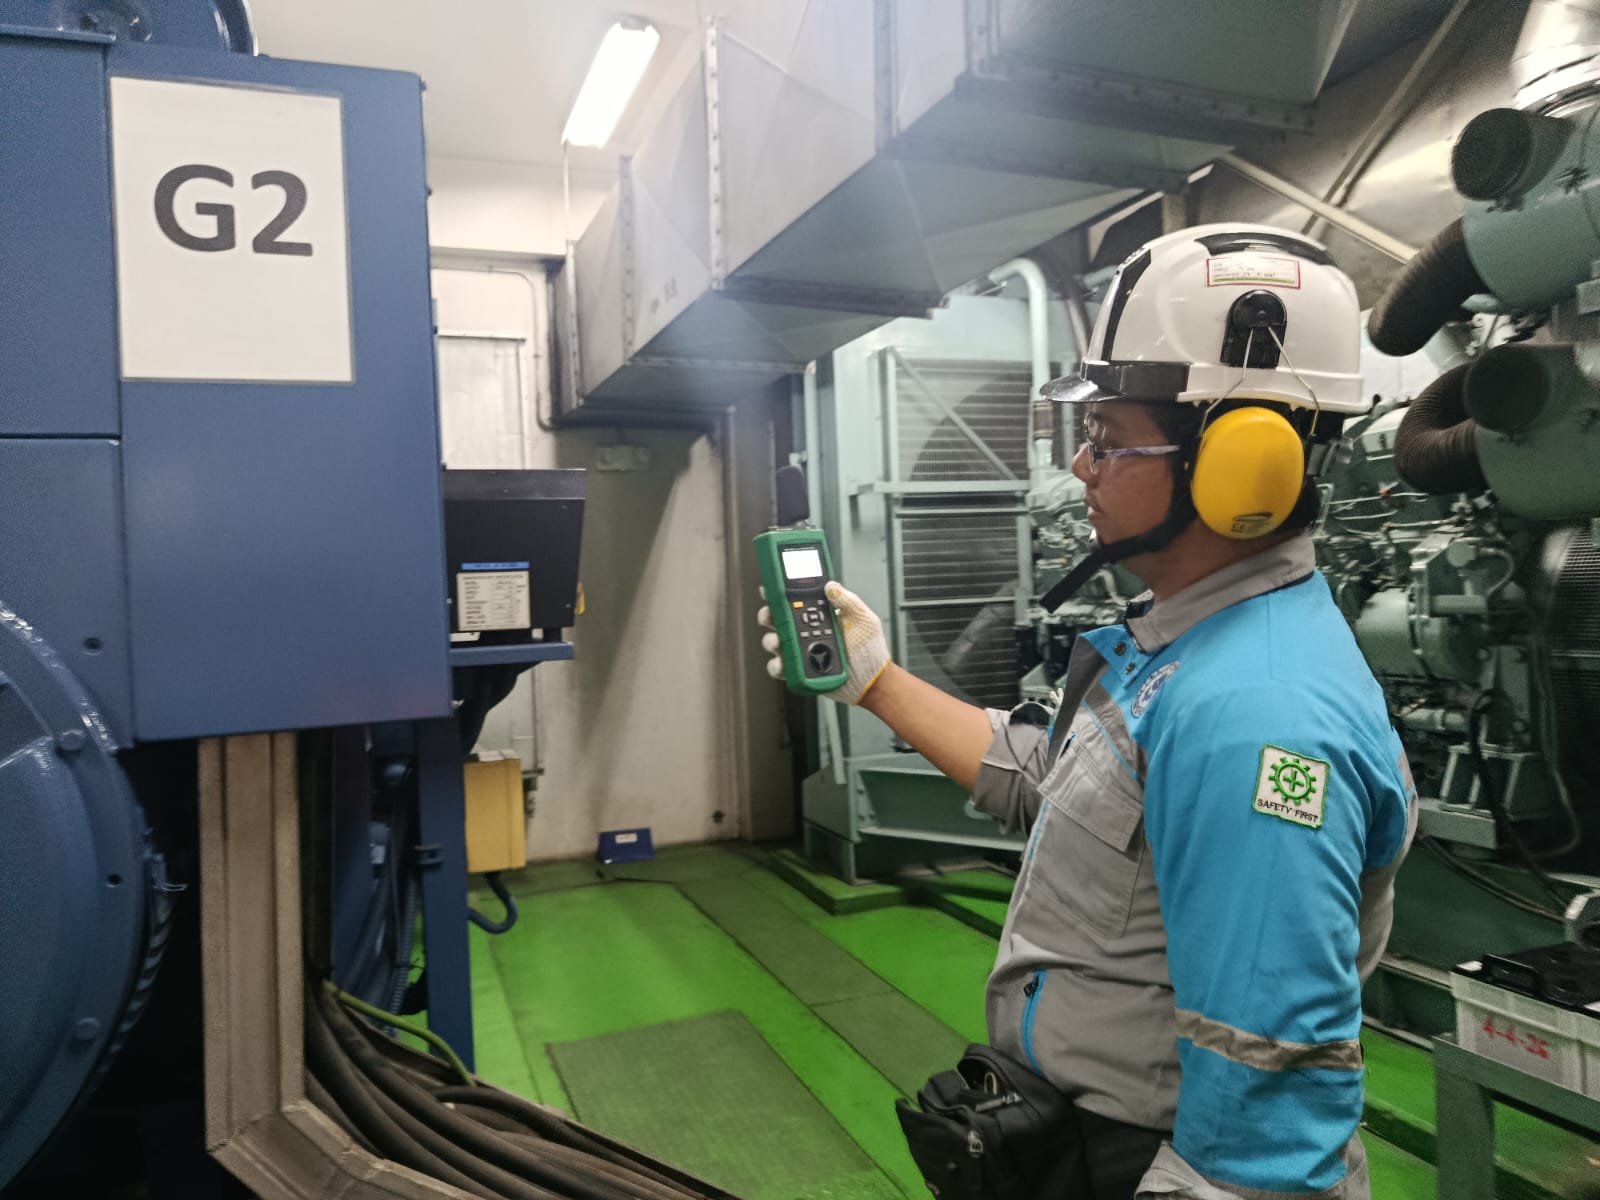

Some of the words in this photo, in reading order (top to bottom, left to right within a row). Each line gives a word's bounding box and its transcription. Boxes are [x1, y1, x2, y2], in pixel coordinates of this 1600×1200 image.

[154, 164, 313, 257] G2
[1257, 798, 1292, 814] SAFETY
[1295, 809, 1319, 822] FIRST
